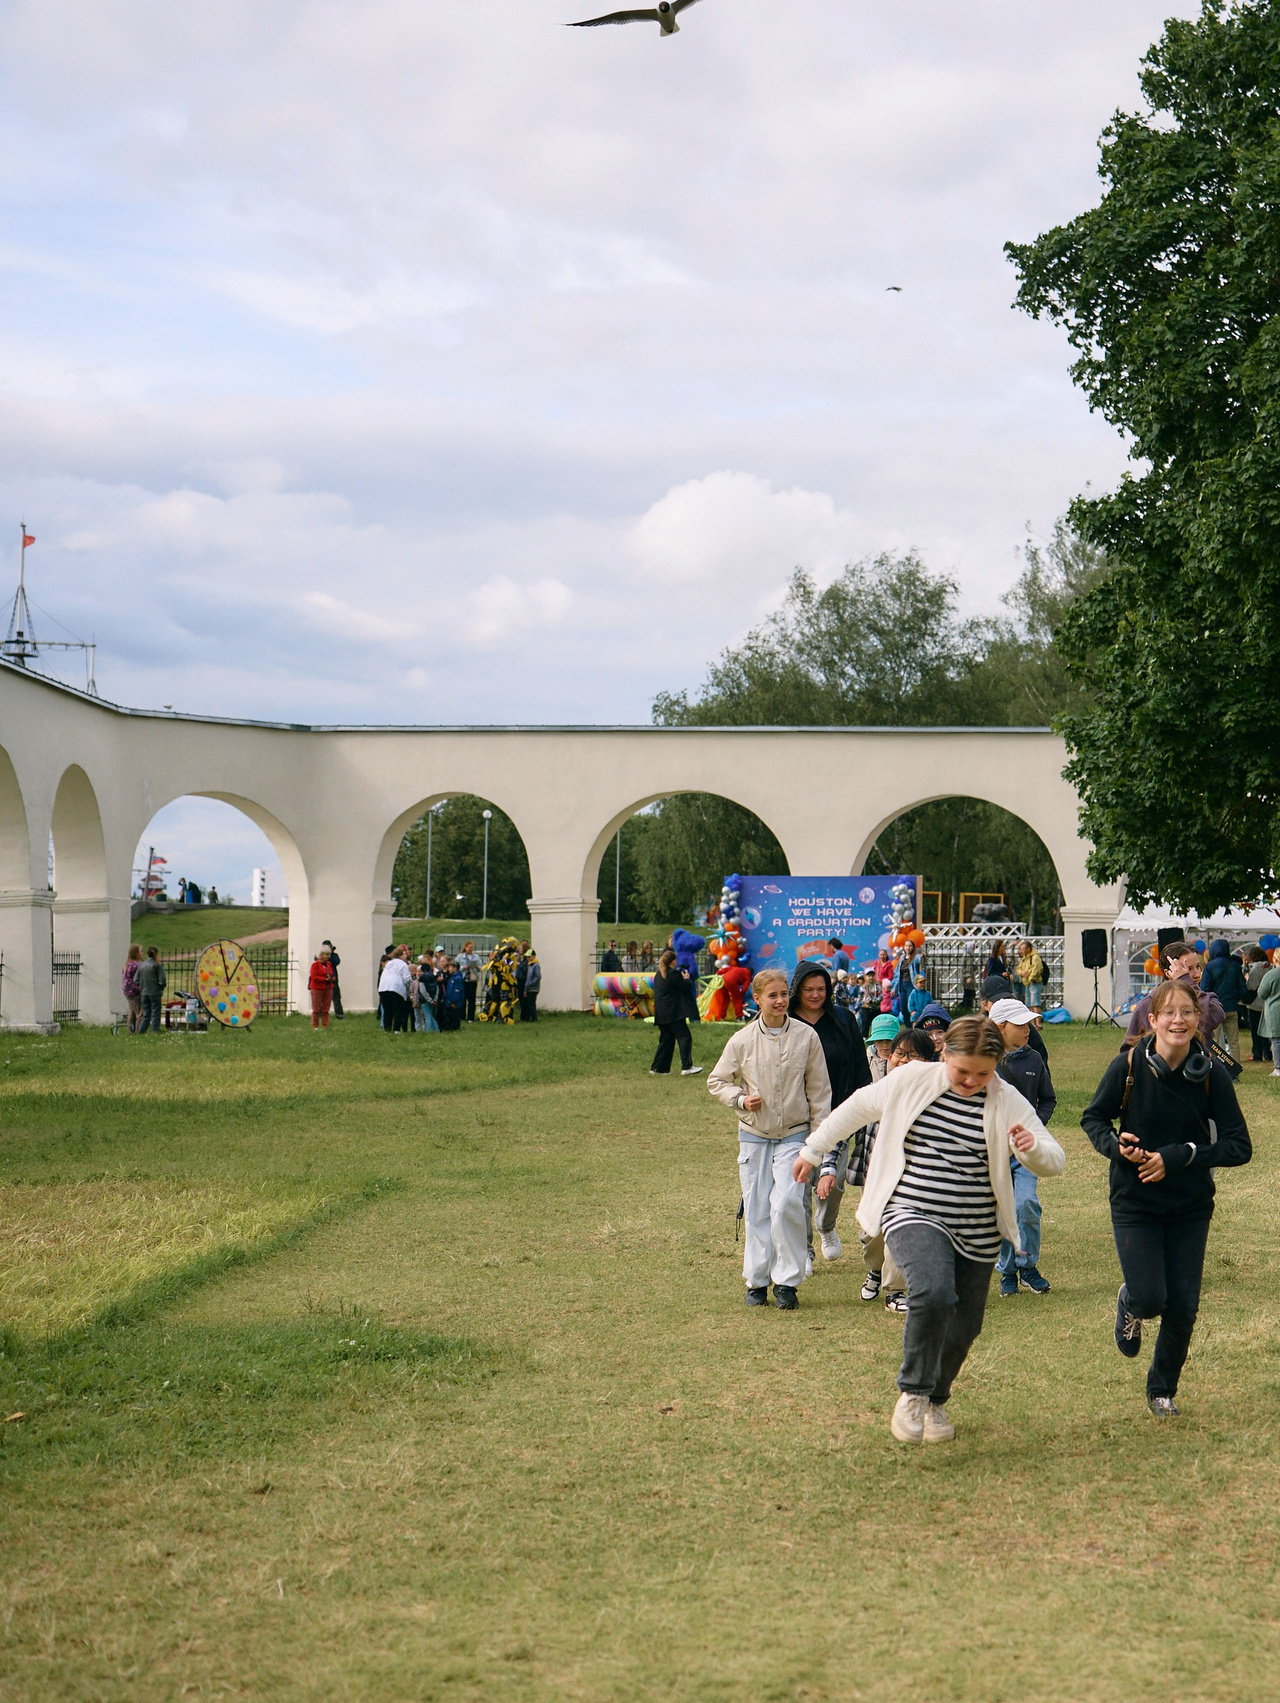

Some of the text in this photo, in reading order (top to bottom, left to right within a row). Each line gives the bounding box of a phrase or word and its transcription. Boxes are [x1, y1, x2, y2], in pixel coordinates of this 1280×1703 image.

[791, 908, 852, 916] WE HAVE
[772, 917, 871, 927] A GRADUATION
[797, 928, 846, 937] PARTY!
